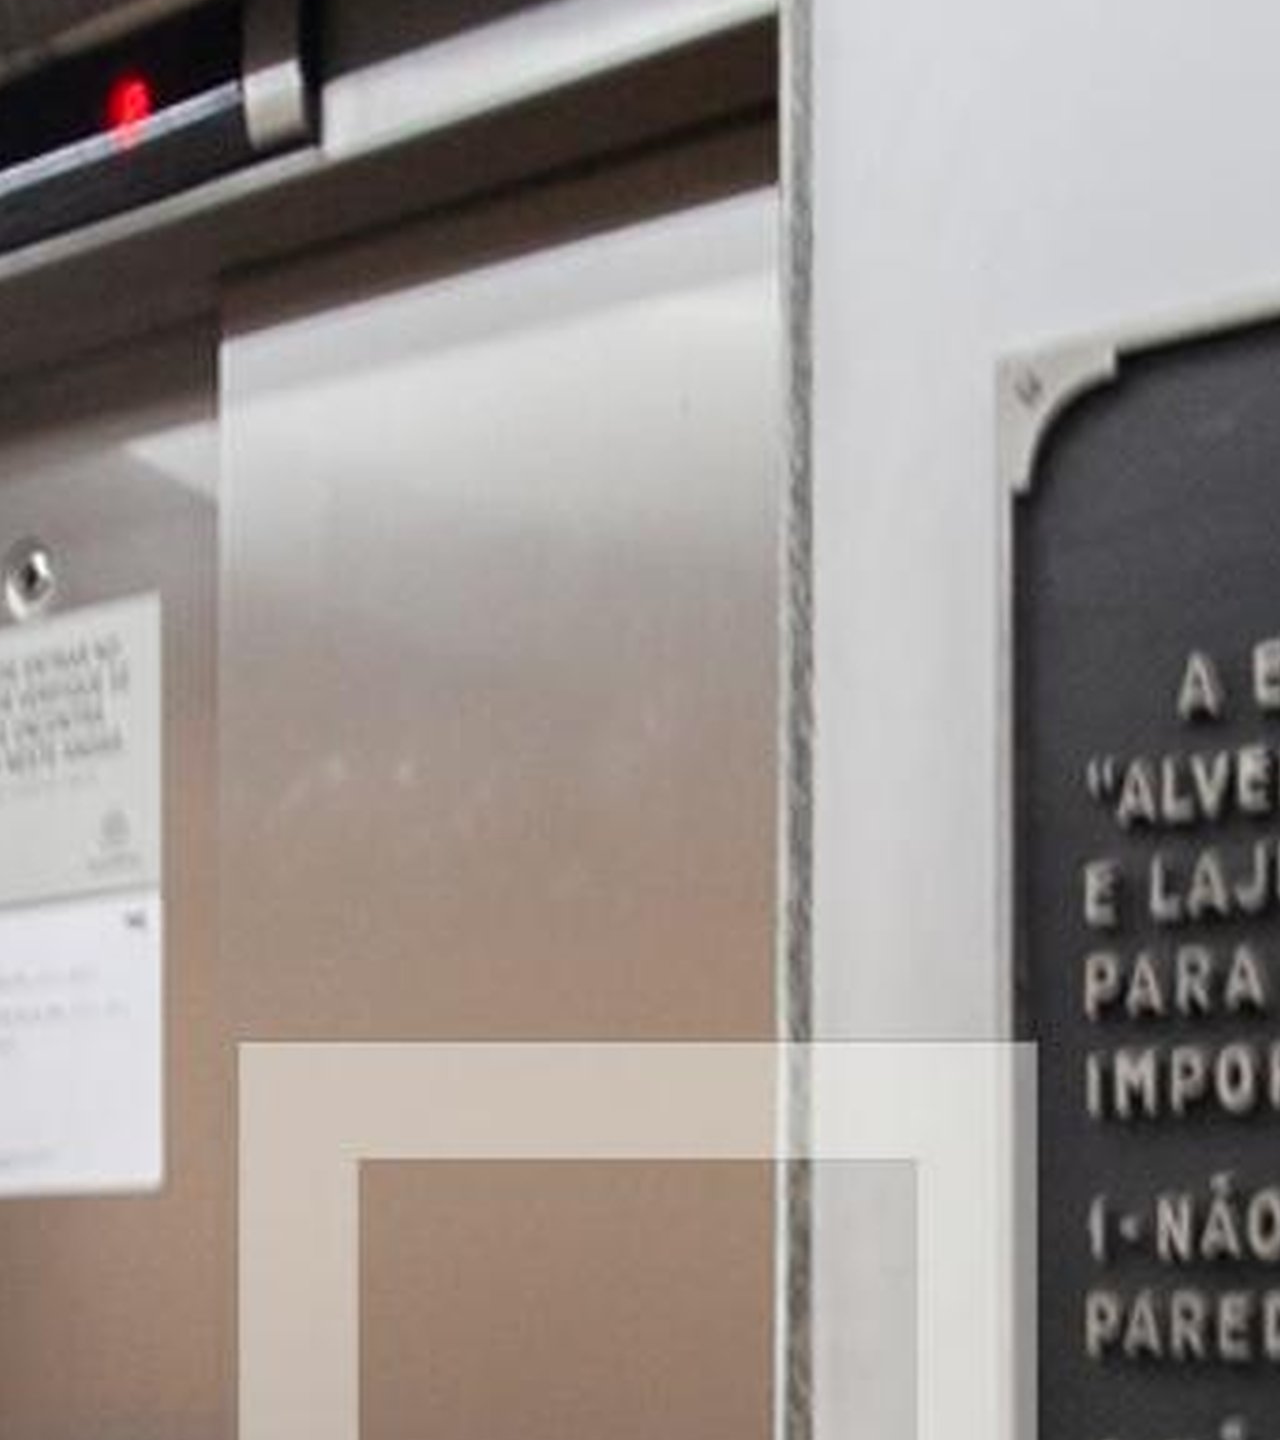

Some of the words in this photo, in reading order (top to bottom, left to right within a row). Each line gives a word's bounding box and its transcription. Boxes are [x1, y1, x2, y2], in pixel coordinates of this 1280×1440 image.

[1177, 650, 1222, 721] A
[1083, 860, 1118, 927] E
[1083, 944, 1266, 1023] PARA
